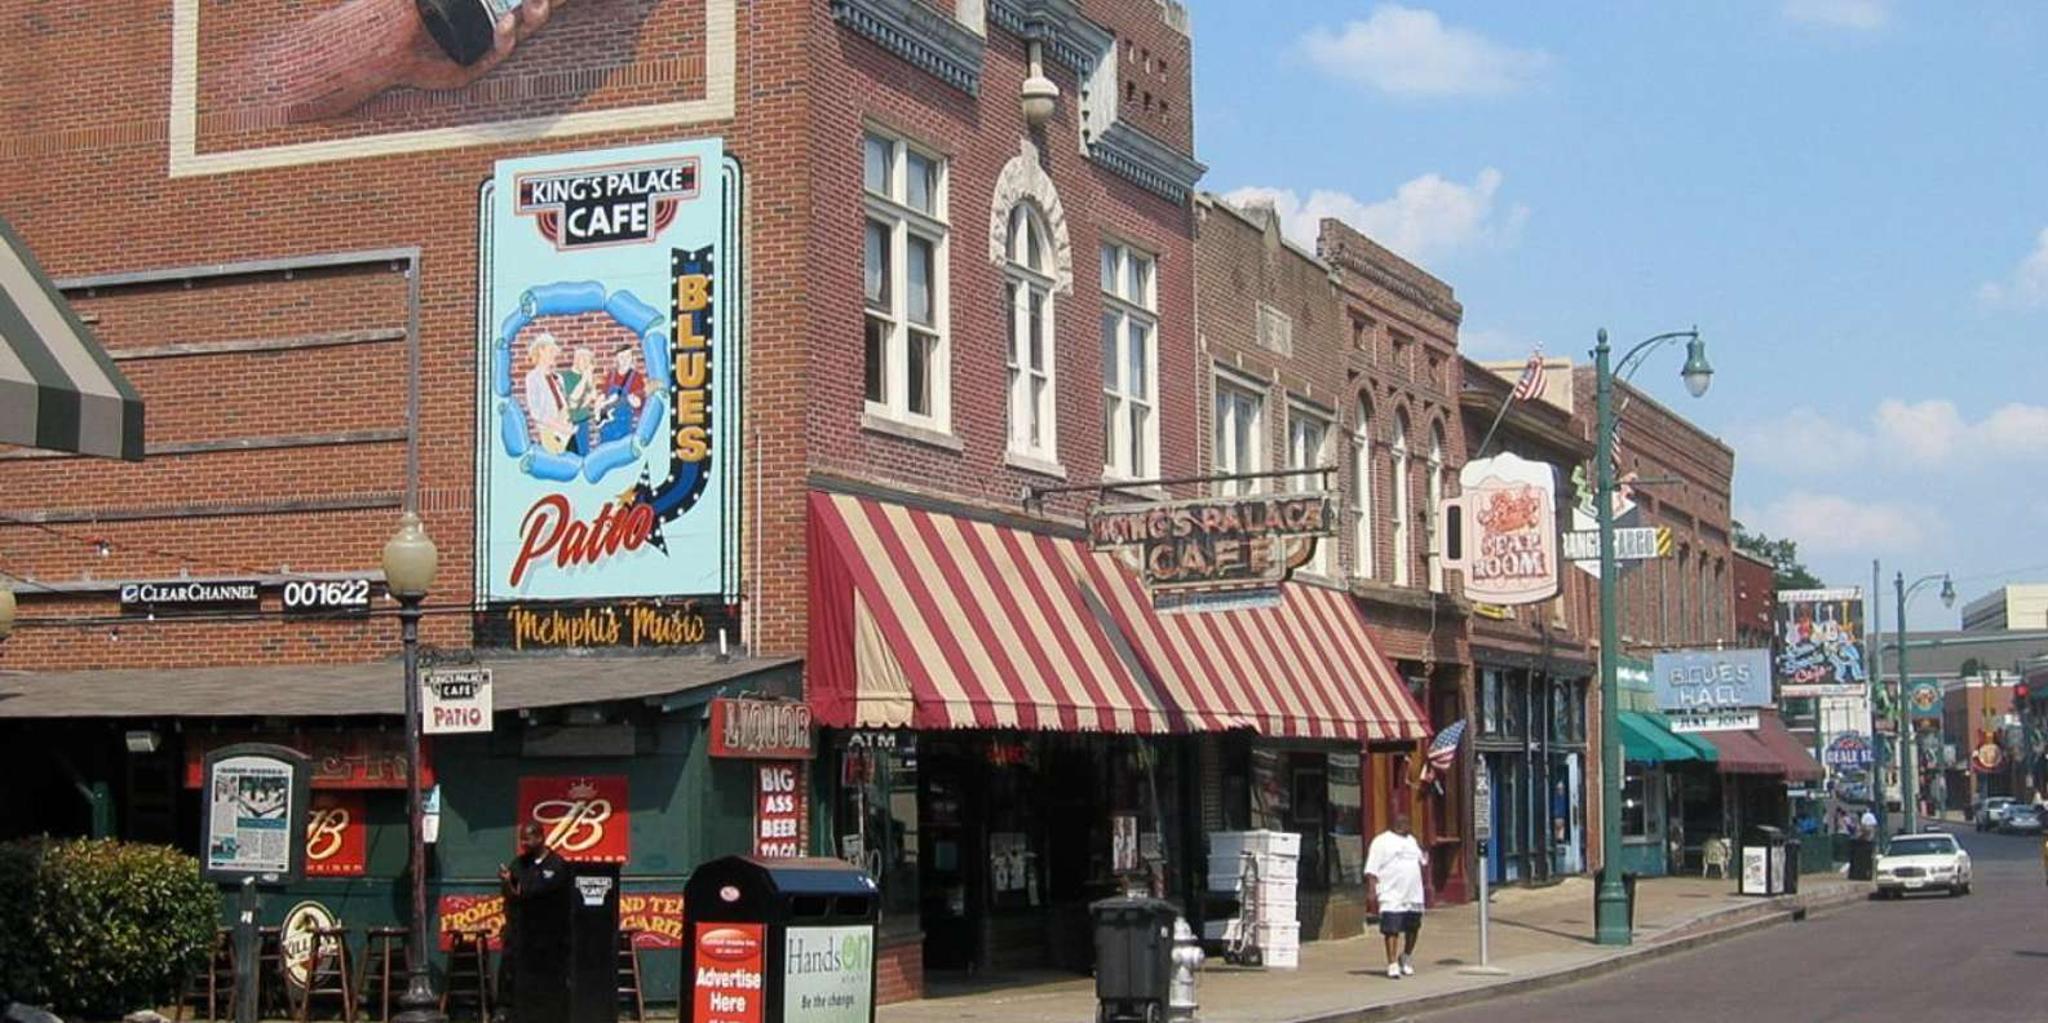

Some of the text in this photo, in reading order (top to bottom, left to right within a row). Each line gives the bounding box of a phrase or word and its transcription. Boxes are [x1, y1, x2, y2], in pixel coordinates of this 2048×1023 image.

[532, 168, 683, 204] KING'S PALACE
[567, 202, 648, 238] CAFE
[677, 275, 707, 463] BLUES
[510, 493, 655, 588] Patio
[1149, 539, 1270, 579] CAFE
[284, 579, 369, 606] 001622
[508, 605, 621, 650] Memphis
[1670, 664, 1750, 686] BLUES
[443, 684, 471, 696] CAFE
[1679, 686, 1741, 705] HALL
[725, 702, 811, 751] LIQUOR
[850, 733, 895, 748] ATM
[760, 767, 794, 792] BIG
[765, 795, 793, 813] ASS
[760, 818, 797, 838] BEER
[440, 896, 505, 933] FROZE
[619, 896, 646, 914] ND
[696, 967, 762, 989] Advertise
[709, 991, 746, 1013] Here
[801, 994, 812, 1010] Be
[813, 993, 826, 1008] the
